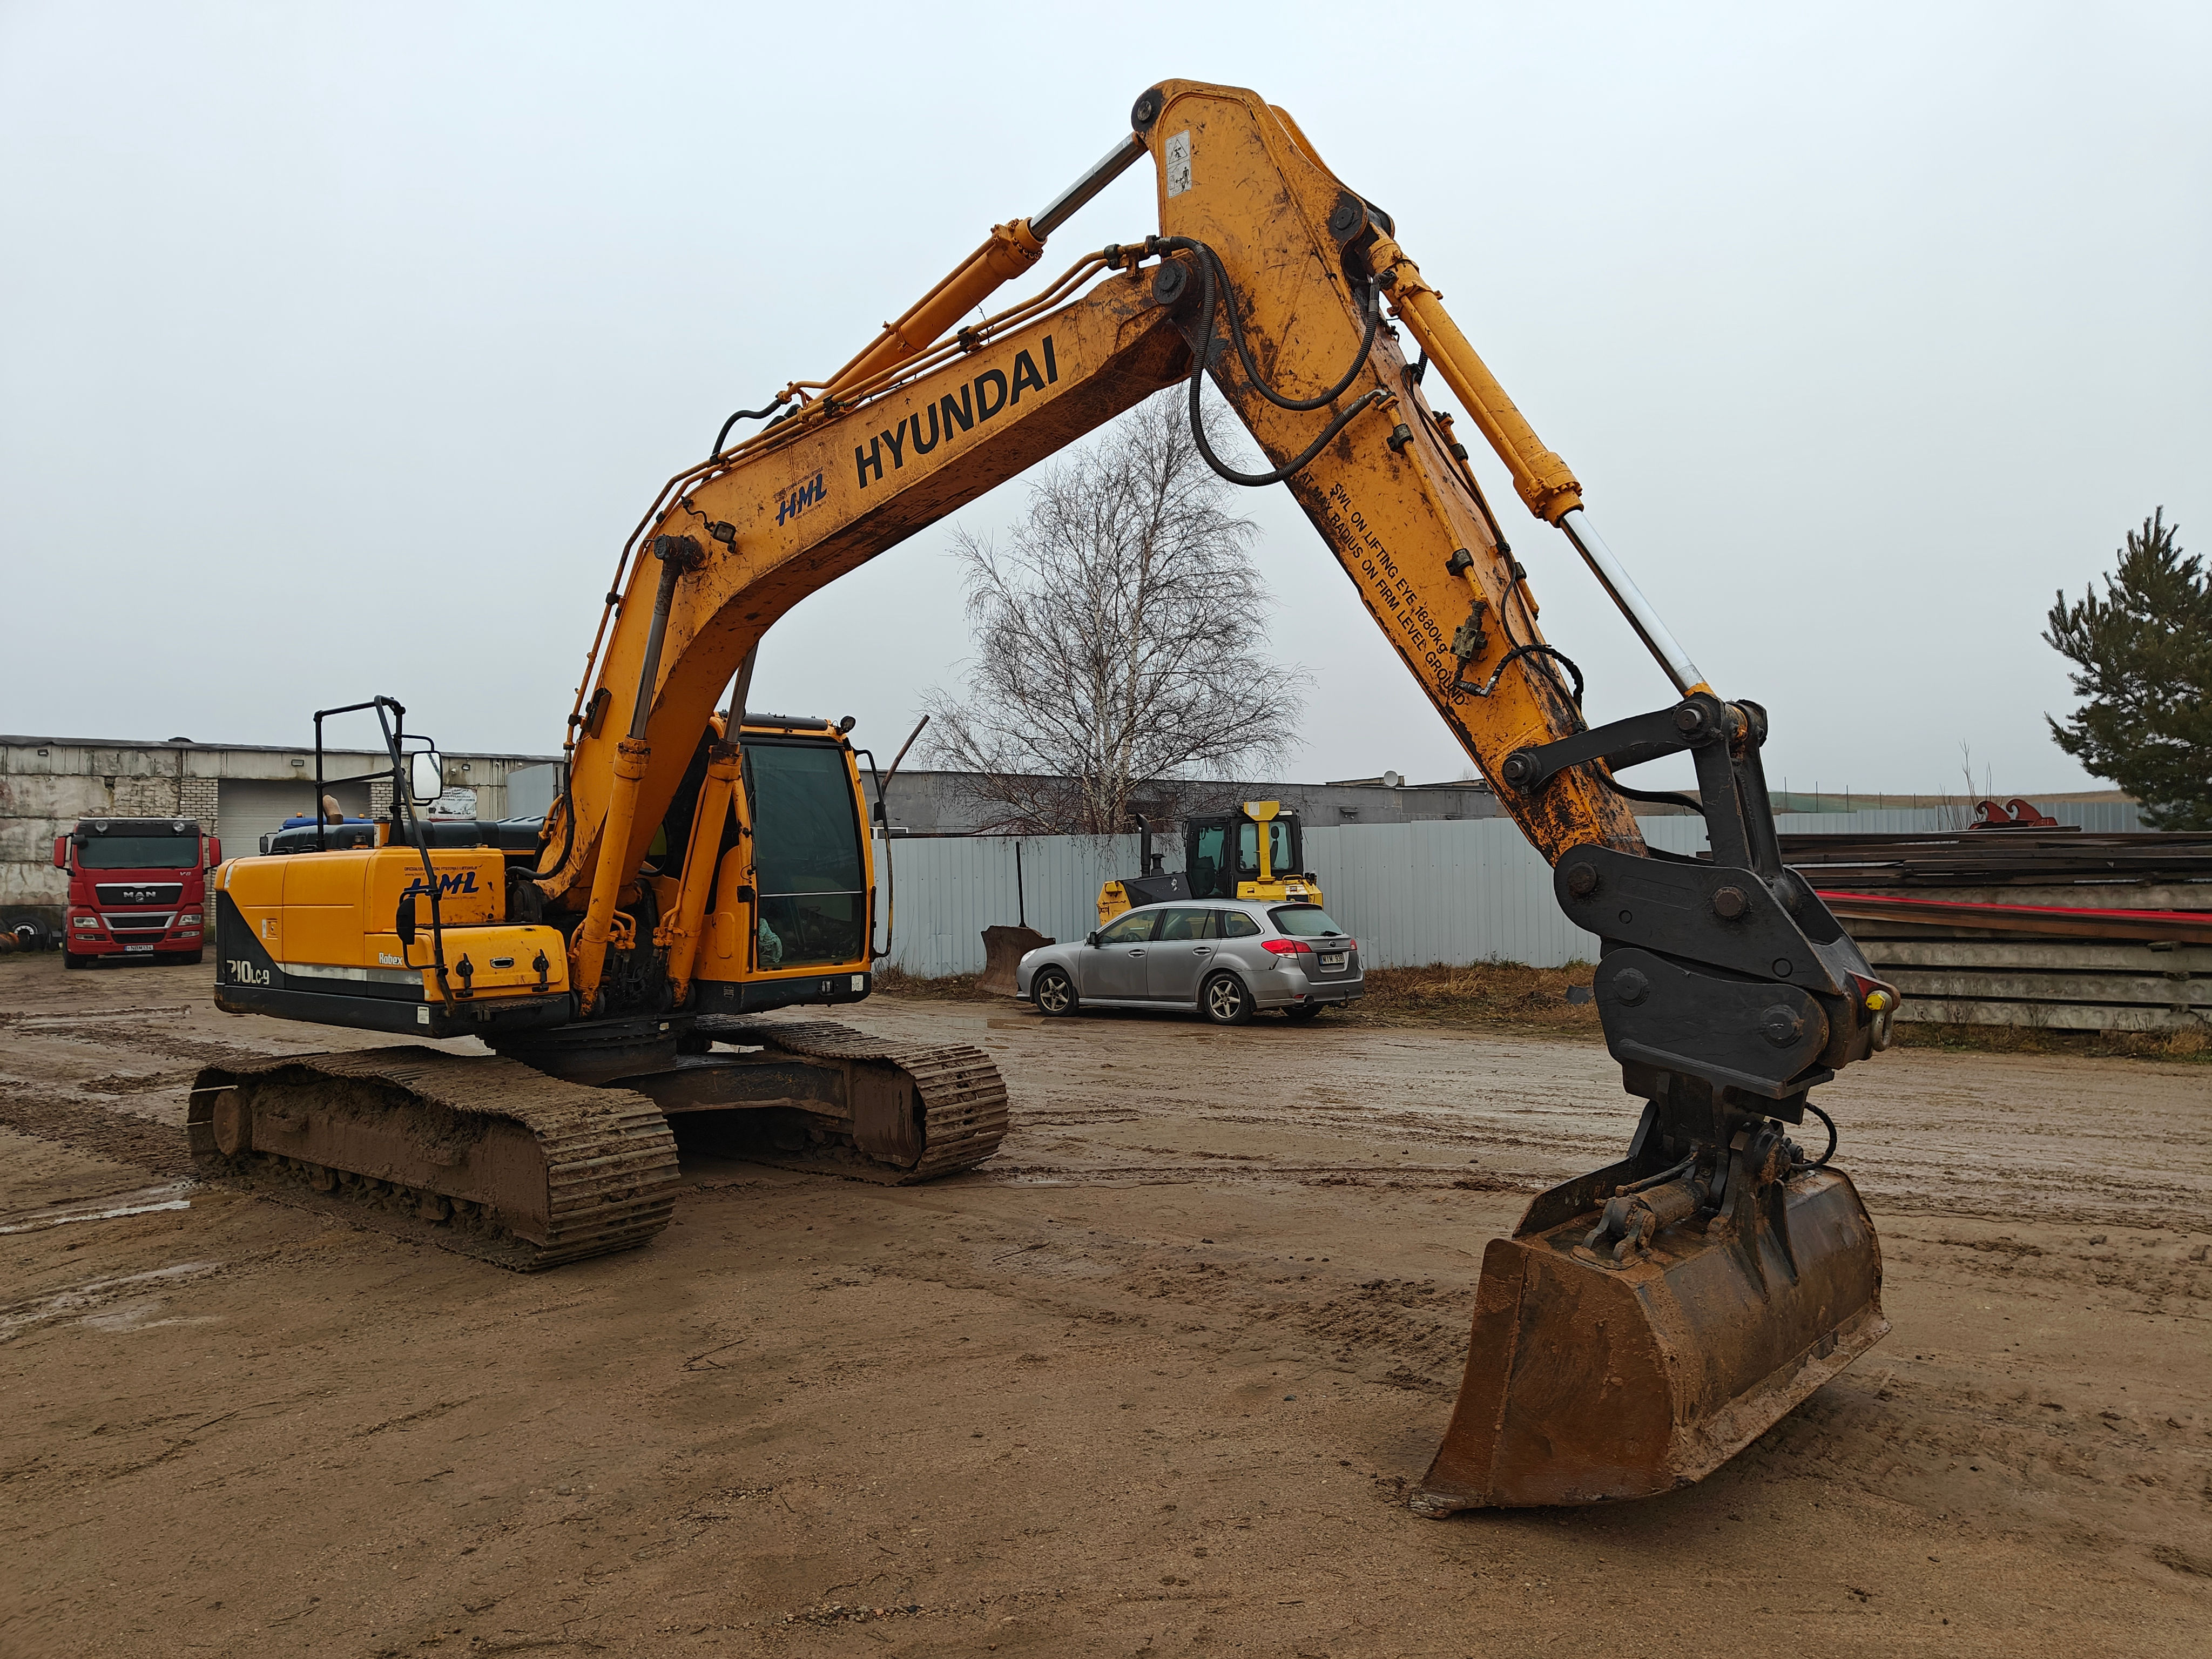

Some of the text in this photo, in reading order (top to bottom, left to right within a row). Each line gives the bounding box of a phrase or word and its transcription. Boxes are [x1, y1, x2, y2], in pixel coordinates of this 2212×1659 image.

[855, 334, 1058, 489] HYUNDAI
[775, 474, 827, 527] HML
[1334, 483, 1448, 654] SWL ON LIFTING EYE 1880kg
[1299, 471, 1314, 485] AT
[1331, 512, 1363, 558] RADIUS
[1361, 559, 1378, 580] ON
[1375, 578, 1400, 611] FIRM
[1397, 610, 1426, 651] LEVEL
[1425, 651, 1465, 705] GROUND
[379, 952, 403, 966] Robex
